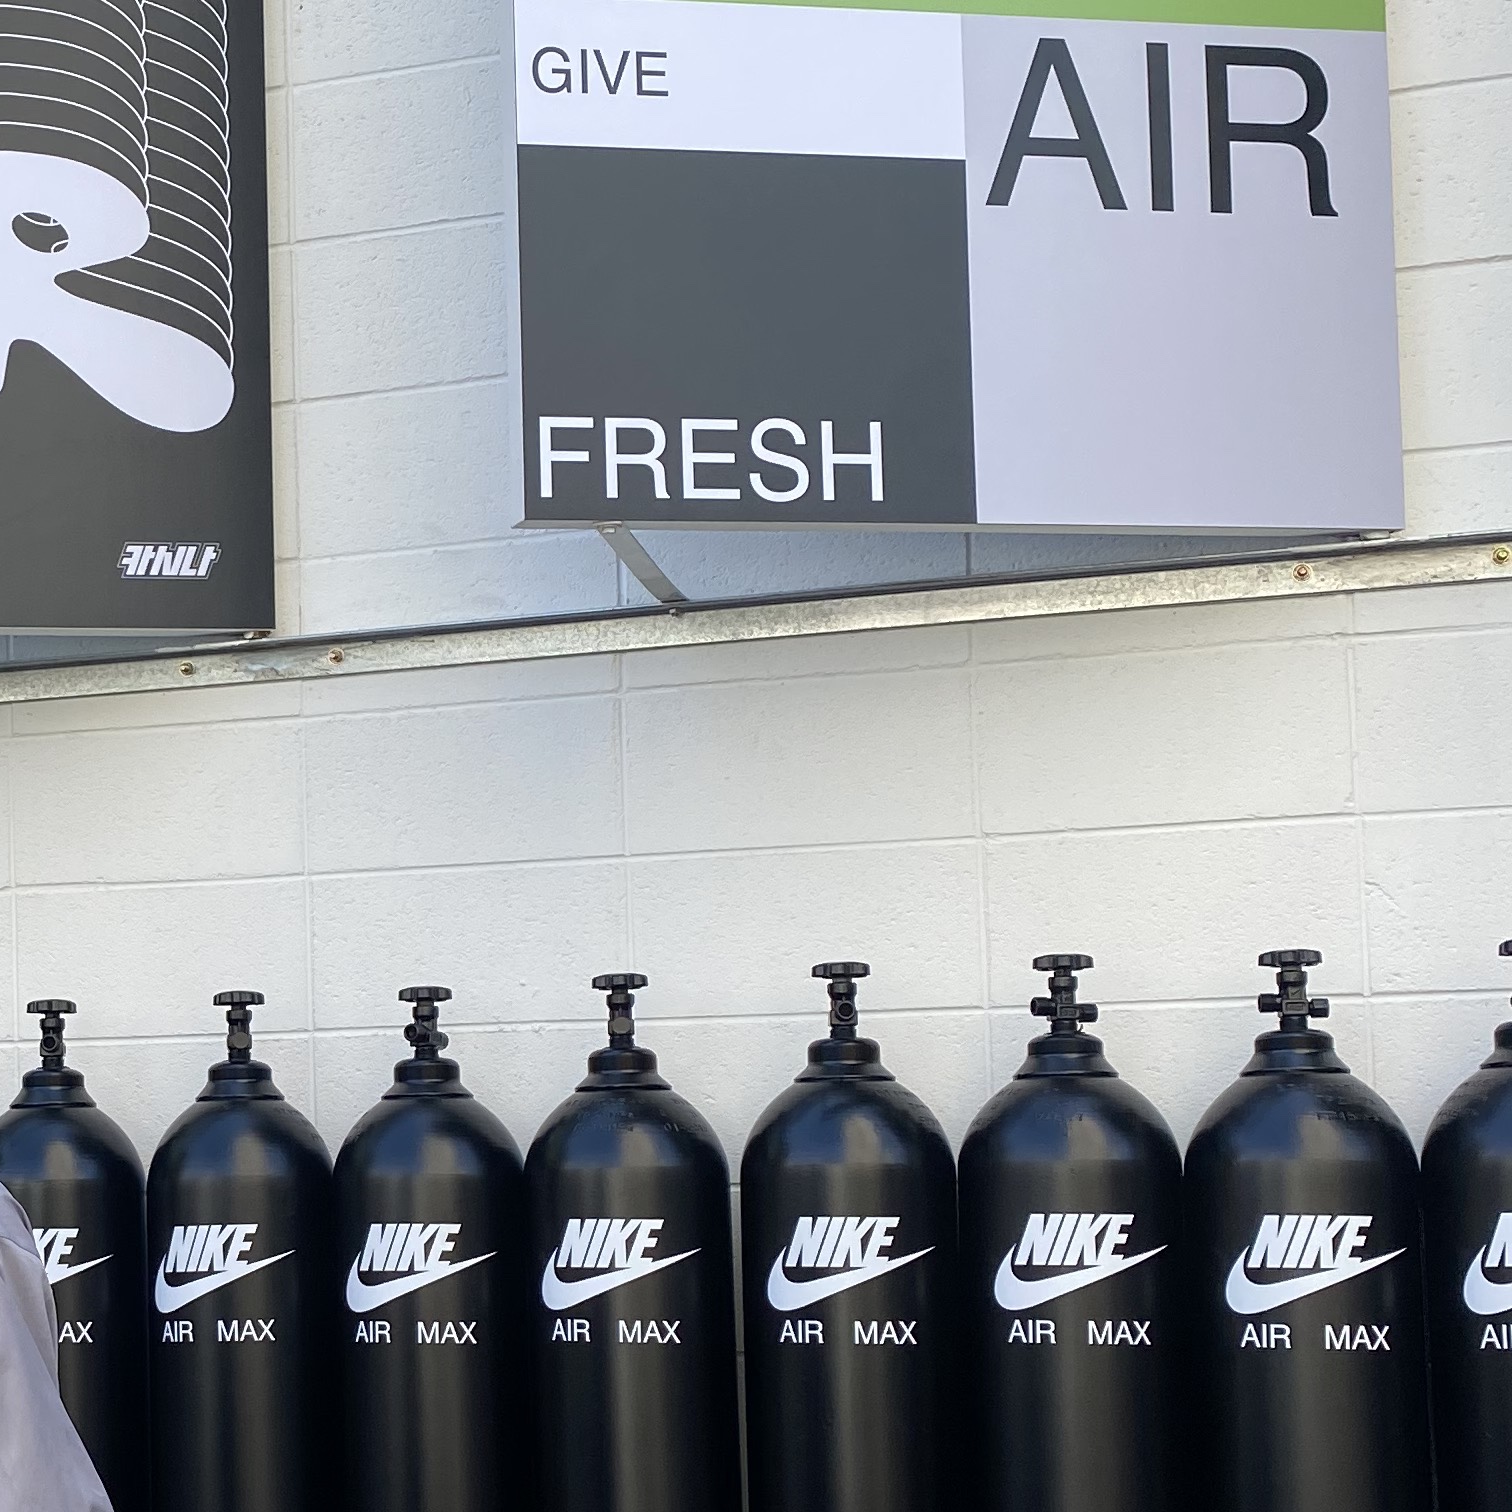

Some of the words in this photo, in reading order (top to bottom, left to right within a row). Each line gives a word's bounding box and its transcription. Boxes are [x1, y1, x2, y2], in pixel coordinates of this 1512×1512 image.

[532, 46, 669, 97] GIVE
[985, 37, 1339, 218] AIR
[538, 415, 885, 503] FRESH
[32, 1228, 80, 1271] KE
[165, 1223, 259, 1273] NIKE
[358, 1223, 462, 1272] NIKE
[556, 1218, 665, 1268] NIKE
[785, 1216, 900, 1267] NIKE
[1014, 1213, 1134, 1265] NIKE
[1248, 1214, 1373, 1268] NIKE
[58, 1321, 94, 1344] AX
[162, 1320, 194, 1343] AIR
[217, 1318, 276, 1342] MAX
[355, 1320, 392, 1344] AIR
[417, 1321, 478, 1345] MAX
[551, 1318, 591, 1343] AIR
[618, 1319, 681, 1344] MAX
[779, 1319, 825, 1344] AIR
[854, 1320, 918, 1345] MAX
[1007, 1319, 1057, 1344] AIR
[1087, 1320, 1152, 1346] MAX
[1240, 1323, 1292, 1349] AIR
[1324, 1324, 1391, 1351] MAX
[1480, 1323, 1512, 1350] AI
